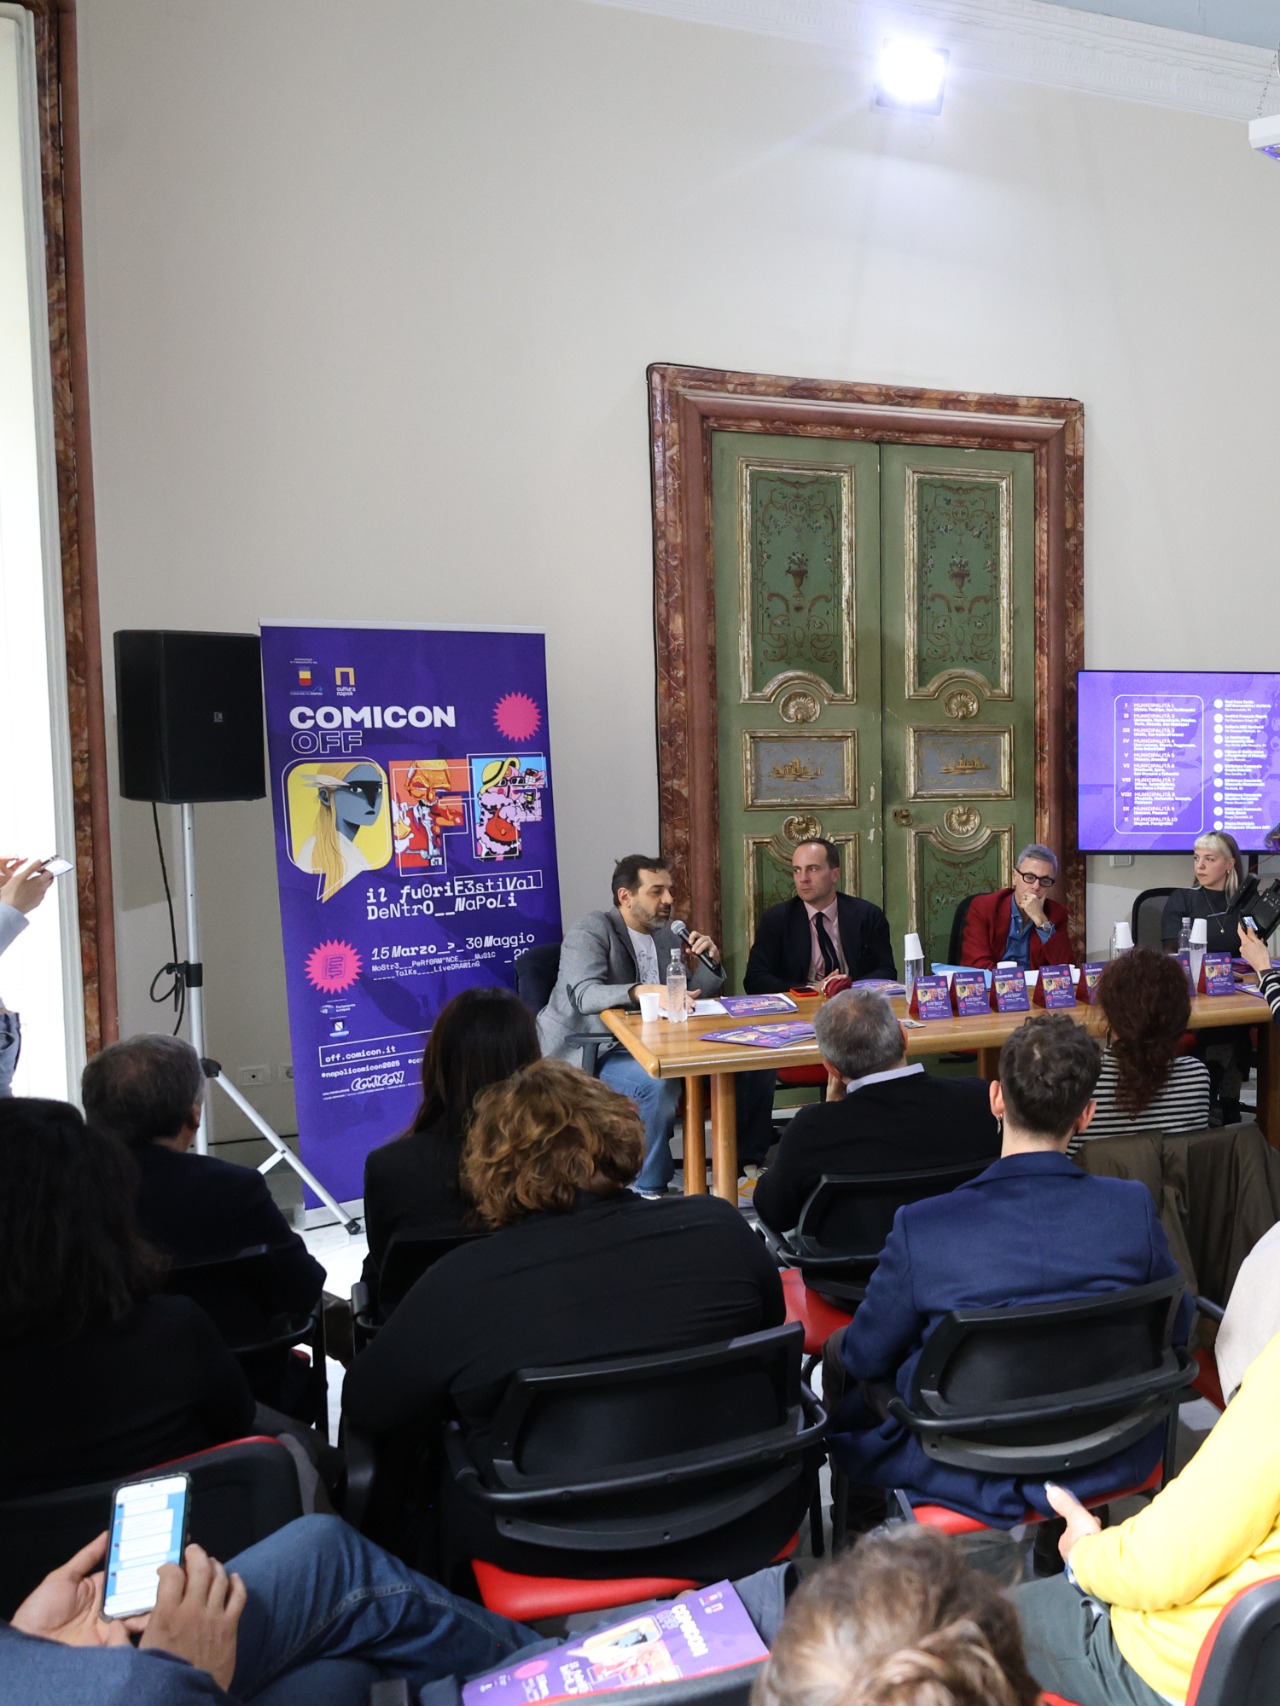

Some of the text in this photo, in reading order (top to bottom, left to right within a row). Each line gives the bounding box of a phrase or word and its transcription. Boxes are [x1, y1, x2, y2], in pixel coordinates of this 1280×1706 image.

[289, 706, 456, 729] COMICON
[291, 730, 363, 755] OFF
[366, 887, 388, 903] il
[325, 1045, 396, 1063] off.comicon.it
